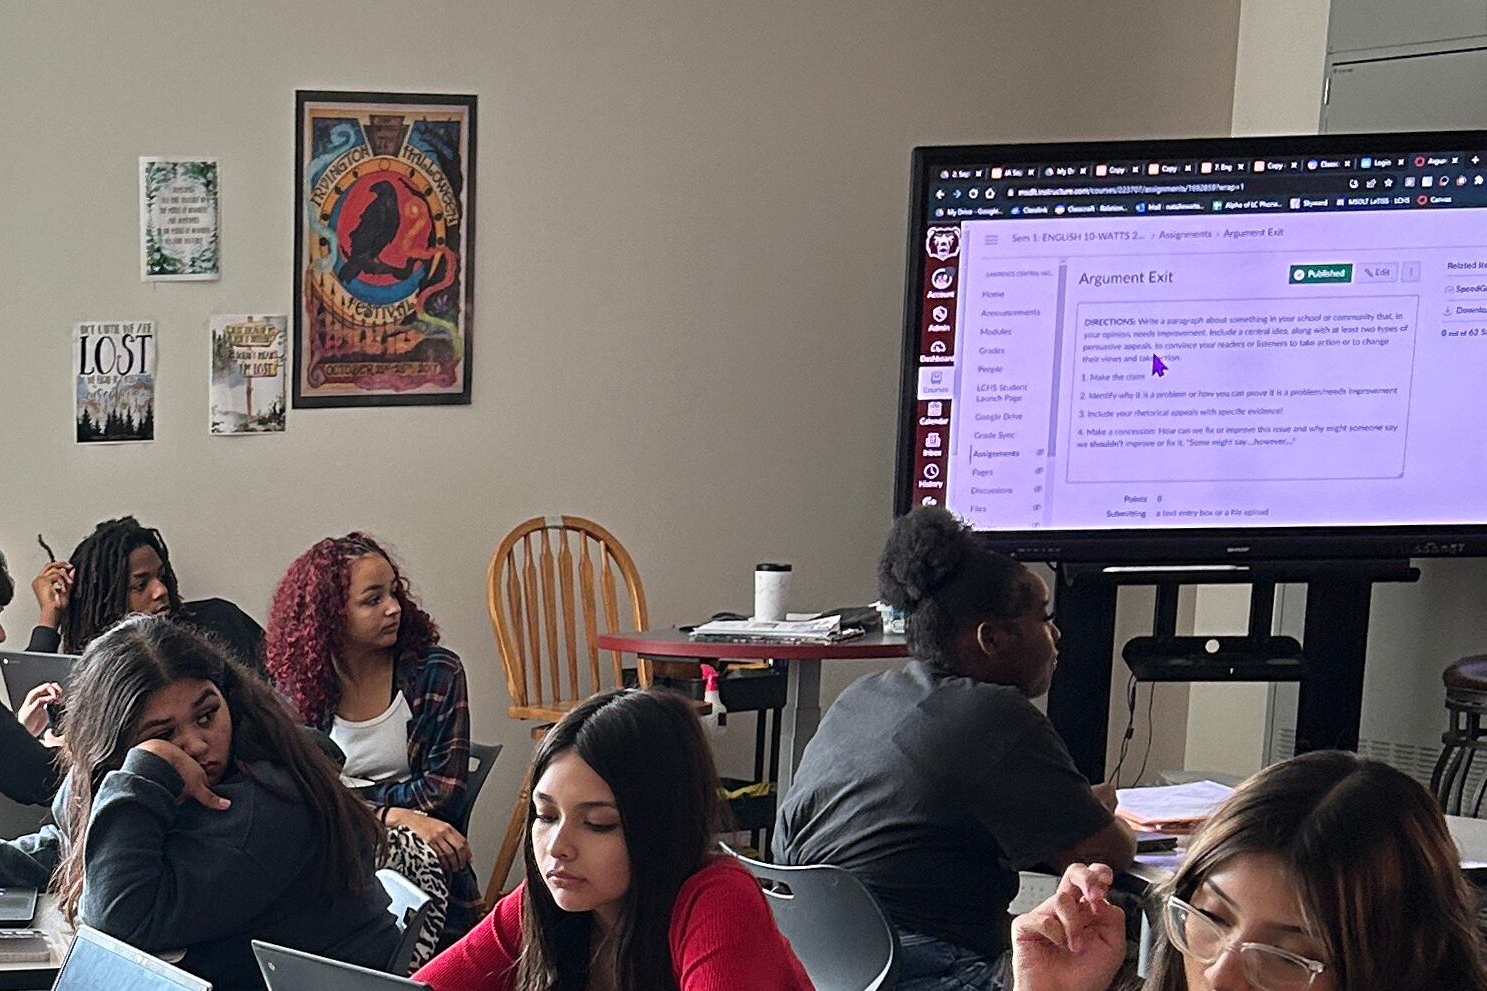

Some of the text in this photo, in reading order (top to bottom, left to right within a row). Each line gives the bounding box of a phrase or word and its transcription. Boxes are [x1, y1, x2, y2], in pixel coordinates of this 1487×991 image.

[310, 144, 370, 207] IRVINGTON
[402, 145, 459, 226] HALLOWEEN
[1042, 232, 1081, 242] ENGLISH
[1159, 229, 1212, 241] Assignments
[1223, 229, 1265, 238] Argument
[1267, 228, 1284, 237] Exit
[1307, 269, 1346, 278] Published
[1375, 268, 1390, 276] Edit
[1079, 271, 1173, 287] Argument Exit
[346, 297, 416, 319] FESTIVAL
[981, 309, 1040, 317] Announcements
[1167, 317, 1204, 327] paragraph
[1297, 314, 1321, 322] school
[1332, 313, 1374, 322] community
[928, 324, 951, 332] Admin
[980, 328, 1012, 336] Modules
[1133, 330, 1155, 338] needs
[1245, 327, 1270, 335] central
[1291, 327, 1311, 335] along
[1314, 326, 1330, 334] with
[1377, 326, 1398, 334] types
[1083, 343, 1122, 351] persuasive
[1199, 342, 1215, 350] your
[1256, 340, 1288, 348] listeners
[1300, 339, 1315, 347] take
[1317, 339, 1340, 347] action
[1362, 338, 1389, 346] change
[80, 334, 152, 375] LOST
[1082, 355, 1100, 363] their
[1101, 355, 1122, 363] views
[326, 364, 375, 376] OCTOBER
[1112, 373, 1124, 381] the
[923, 386, 949, 394] Courses
[1089, 392, 1117, 400] Identify
[1156, 391, 1187, 399] problem
[1198, 390, 1214, 398] how
[1246, 390, 1267, 398] prove
[1348, 387, 1398, 395] improvement
[1004, 394, 1022, 402] Page
[975, 413, 1001, 422] Google
[1087, 408, 1246, 418] Include your rhetorical appeals with specific
[1087, 428, 1107, 436] Make
[1158, 427, 1176, 435] How
[1205, 426, 1214, 434] fix
[1257, 425, 1271, 433] this
[1309, 425, 1324, 433] why
[1326, 425, 1347, 433] might
[1349, 424, 1383, 432] someone
[974, 431, 1016, 440] Grade Sync
[1125, 439, 1155, 448] improve
[1167, 438, 1175, 447] fix
[1212, 438, 1233, 447] might
[973, 450, 1020, 458] Assignments
[972, 469, 993, 477] Pages
[918, 481, 943, 489] History
[971, 487, 1013, 495] Discussions
[1124, 495, 1147, 503] Points
[1106, 510, 1146, 518] Submitting
[1244, 508, 1269, 516] upload
